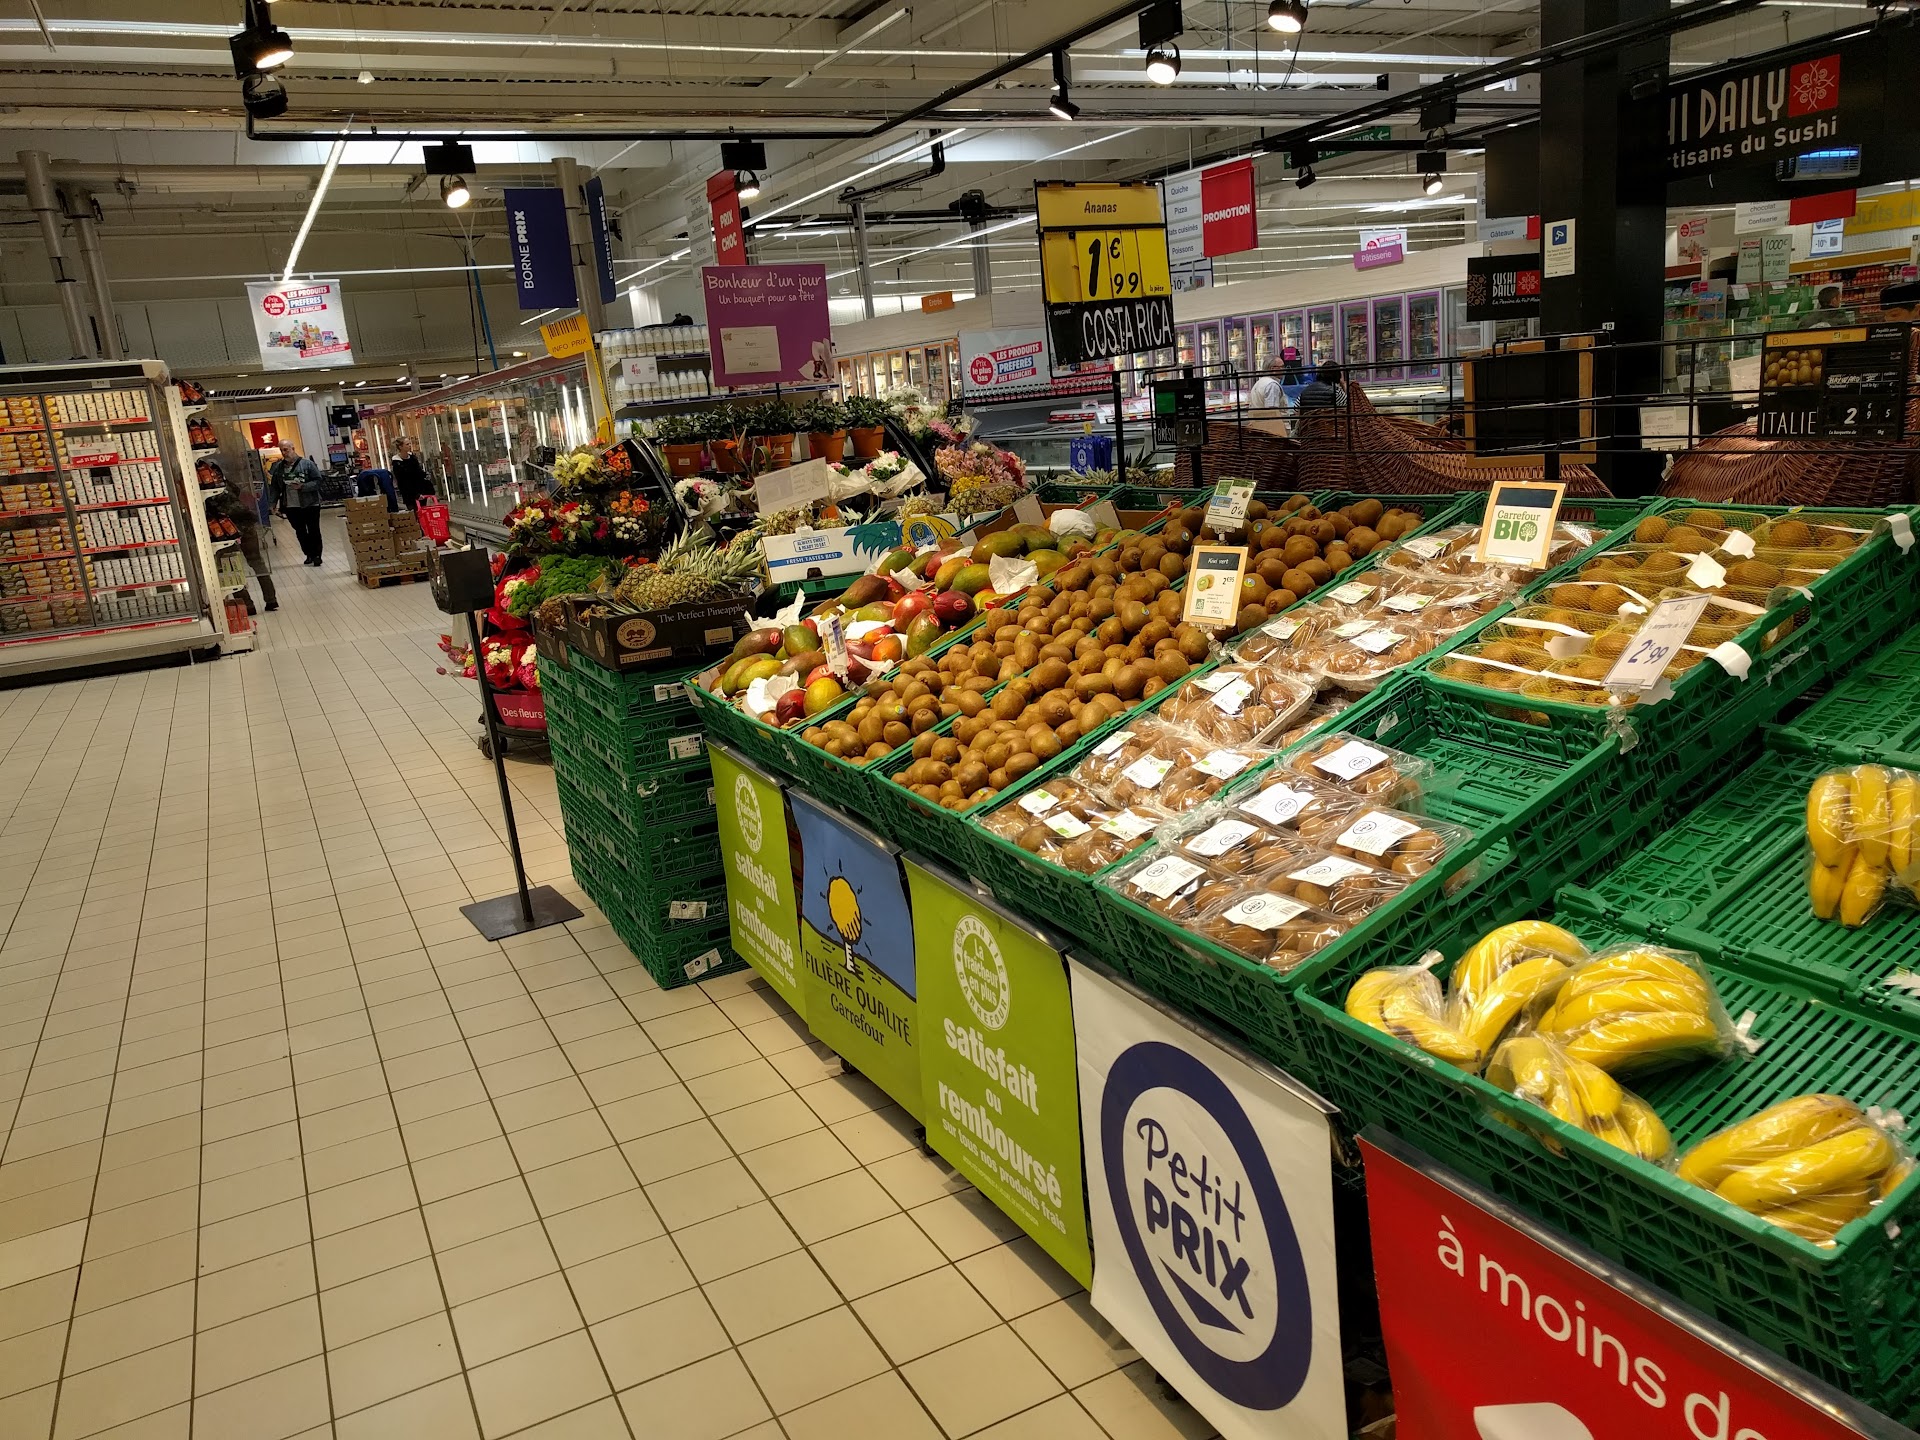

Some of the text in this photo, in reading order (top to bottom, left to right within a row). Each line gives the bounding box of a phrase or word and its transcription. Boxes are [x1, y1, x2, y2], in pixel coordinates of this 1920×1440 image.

[1699, 67, 1786, 139] DAILY
[1668, 115, 1838, 169] tisans du Sushi
[1171, 185, 1189, 196] Quiche
[1084, 201, 1117, 214] Ananas
[1174, 206, 1188, 215] Pizza
[1203, 203, 1251, 224] PROMOTION
[1750, 203, 1776, 213] chocolat
[720, 209, 734, 229] PRIX
[1748, 216, 1778, 225] Confiserie
[1168, 224, 1198, 236] lats cuisinés
[1490, 230, 1514, 238] Gâteaux
[514, 210, 535, 289] BORNE PRIX
[721, 232, 737, 252] CHOC
[1172, 245, 1194, 255] Poissons
[603, 233, 613, 280] BORNE
[1361, 250, 1392, 263] Pâtisserie
[706, 271, 822, 292] Bonheur d'un jour
[1492, 271, 1517, 285] SUSHI
[287, 286, 328, 299] LES PRODUITS
[718, 290, 815, 306] Un bouquet pour sa fête
[1492, 283, 1517, 298] DAILY
[1082, 300, 1173, 357] COSTA RICA
[552, 338, 588, 353] INFO PRIX
[1772, 336, 1789, 346] Bio
[996, 343, 1039, 360] LES PRODUITS
[975, 359, 987, 368] Prix
[979, 366, 992, 376] plus
[977, 373, 989, 382] bas
[998, 369, 1032, 382] DES FRANÇAIS
[1761, 411, 1818, 435] ITALIE
[1497, 509, 1541, 522] Carrefour
[1493, 519, 1538, 542] BIO
[786, 552, 838, 565] FRESH TASTES BEST
[658, 613, 674, 623] The
[677, 609, 705, 620] Perfect
[502, 707, 543, 718] Des fleurs
[735, 851, 780, 906] satisfait
[755, 896, 765, 913] ou
[735, 899, 794, 969] remboursé
[974, 938, 984, 961] La
[756, 942, 765, 957] nos
[765, 952, 785, 977] produits
[805, 949, 853, 999] FILIÈRE
[856, 986, 912, 1047] QUALITÉ
[969, 975, 997, 1007] en plus
[830, 993, 885, 1047] Carrefour
[943, 1016, 1040, 1116] satisfait
[985, 1087, 1002, 1116] ou
[938, 1080, 1062, 1209] remboursé
[942, 1118, 1067, 1235] sur tous nos produits frais
[1136, 1117, 1246, 1243] Petit
[1144, 1177, 1255, 1320] PRIX
[1436, 1214, 1769, 1440] à moins d
